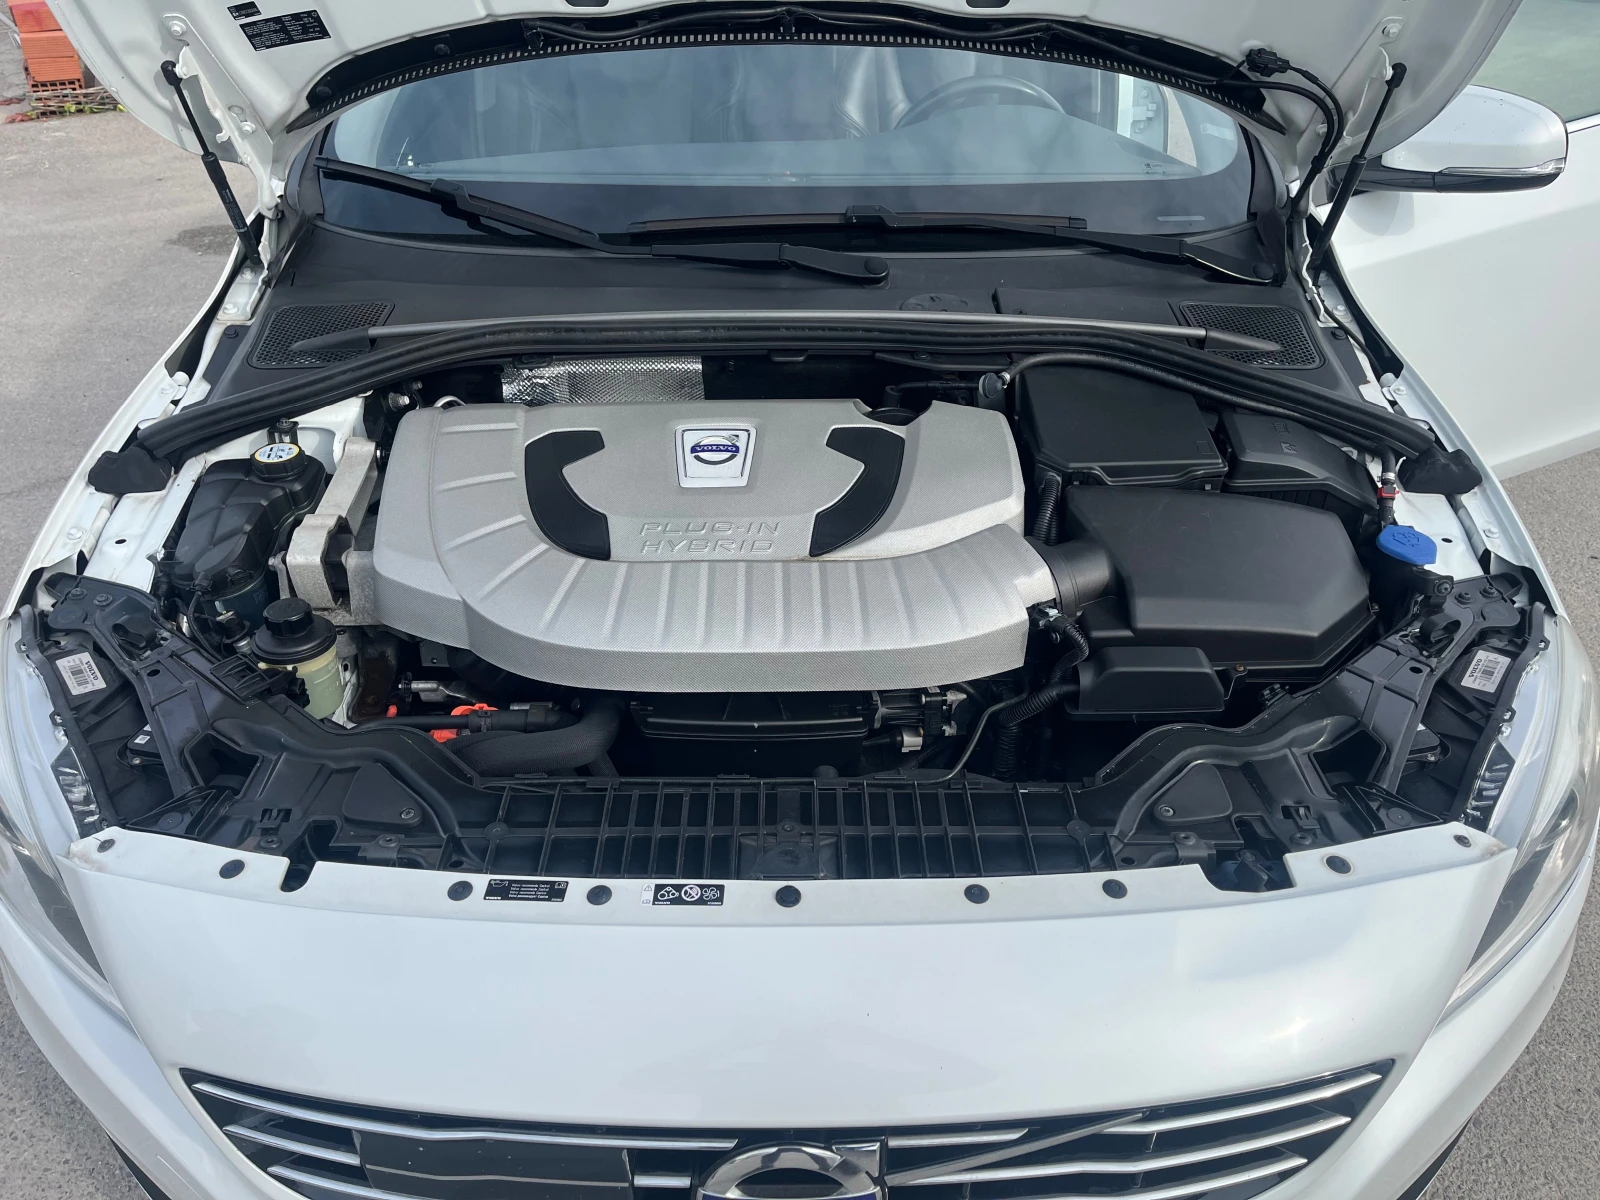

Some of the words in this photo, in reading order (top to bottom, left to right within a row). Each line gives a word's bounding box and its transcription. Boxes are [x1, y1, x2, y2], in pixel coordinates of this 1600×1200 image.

[640, 521, 780, 536] PLUG-IN
[640, 538, 773, 554] HYBRID
[85, 660, 99, 681] VOLVO
[1468, 658, 1483, 678] VOLVO
